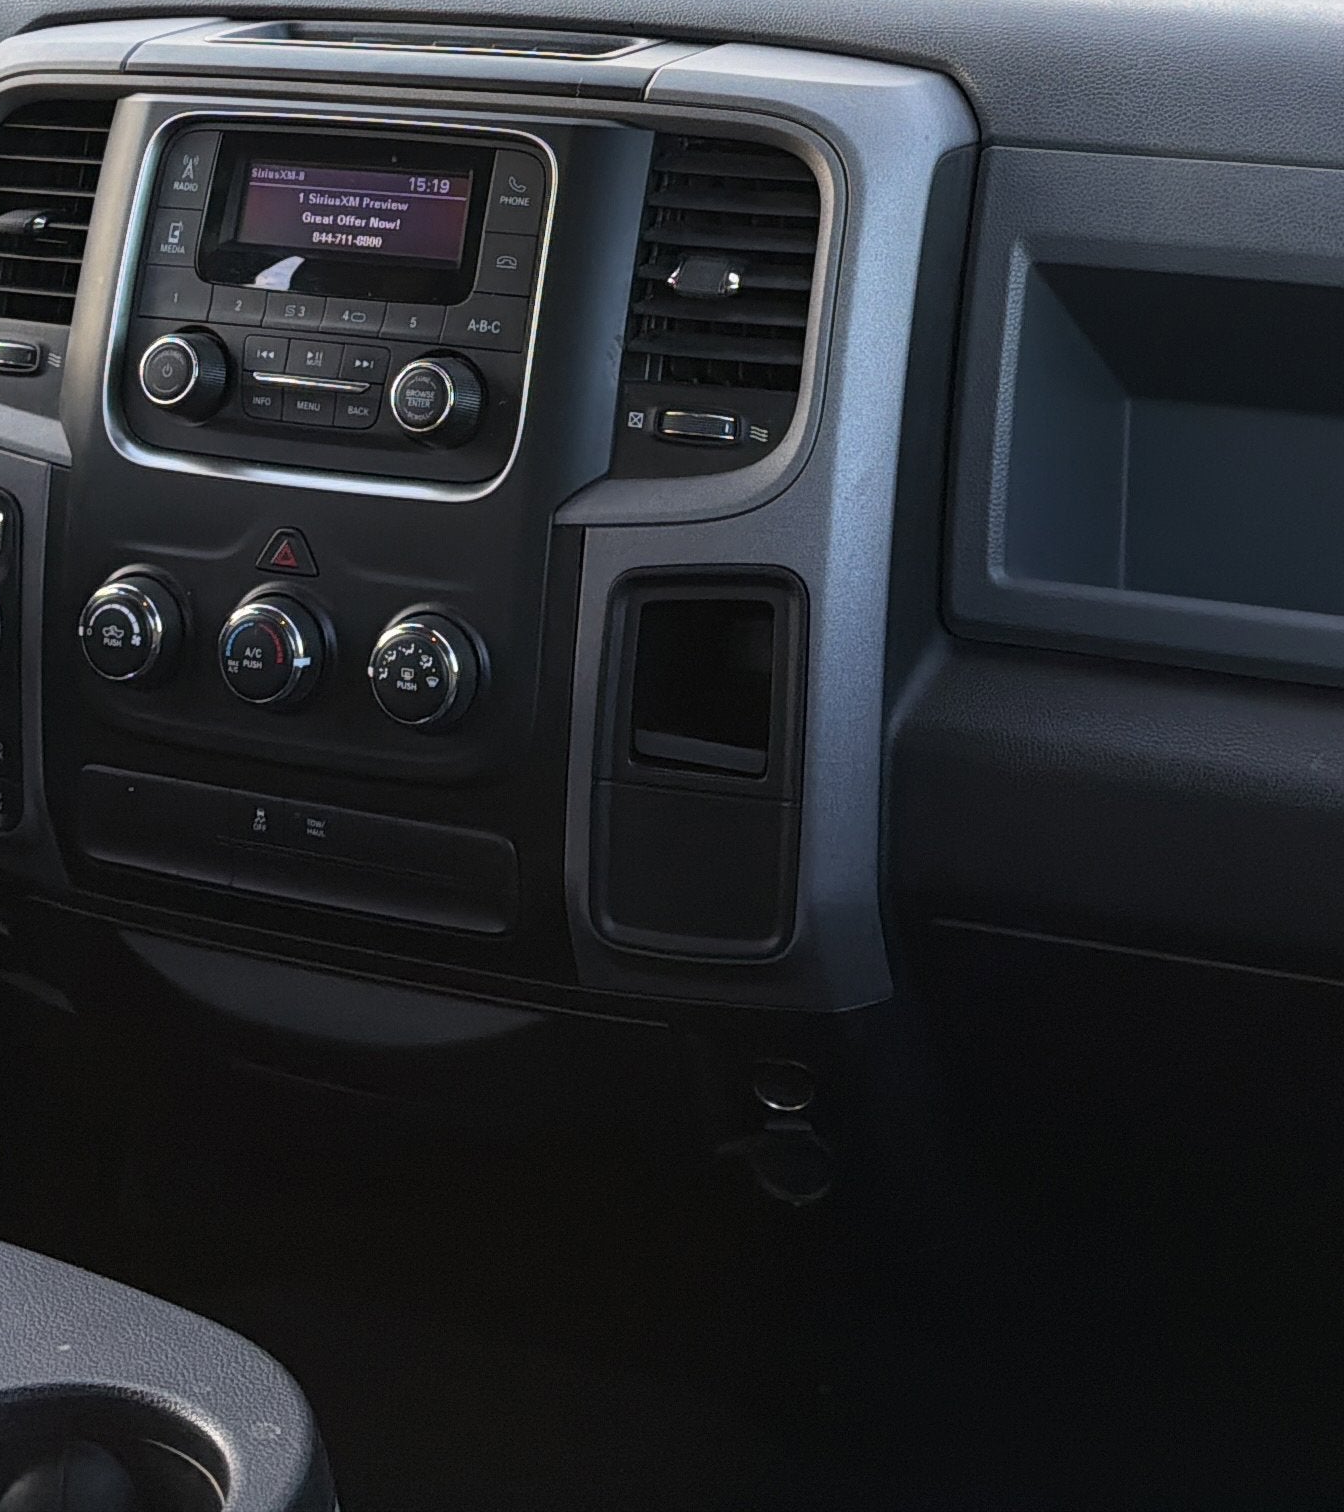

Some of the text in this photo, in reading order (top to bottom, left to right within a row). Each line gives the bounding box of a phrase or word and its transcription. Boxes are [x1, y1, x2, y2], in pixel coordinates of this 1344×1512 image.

[173, 181, 199, 193] RADIO
[409, 176, 451, 194] 15:19
[298, 193, 409, 212] 1 SiriusXM Preview
[499, 195, 531, 207] PHONE
[302, 211, 401, 230] Great Offer Now!
[160, 244, 186, 255] MEDIA
[234, 299, 243, 311] 2
[298, 306, 306, 317] 3
[341, 310, 350, 322] 4
[409, 317, 417, 328] 5
[406, 389, 435, 399] BROWSE
[252, 395, 272, 407] INFO
[296, 400, 322, 412] MENU
[407, 398, 431, 408] ENTER
[347, 405, 370, 417] BACK
[103, 637, 123, 648] PUSH
[244, 647, 263, 659] A/C
[242, 659, 263, 670] PUSH
[396, 680, 418, 691] PUSH
[252, 822, 266, 832] OFF
